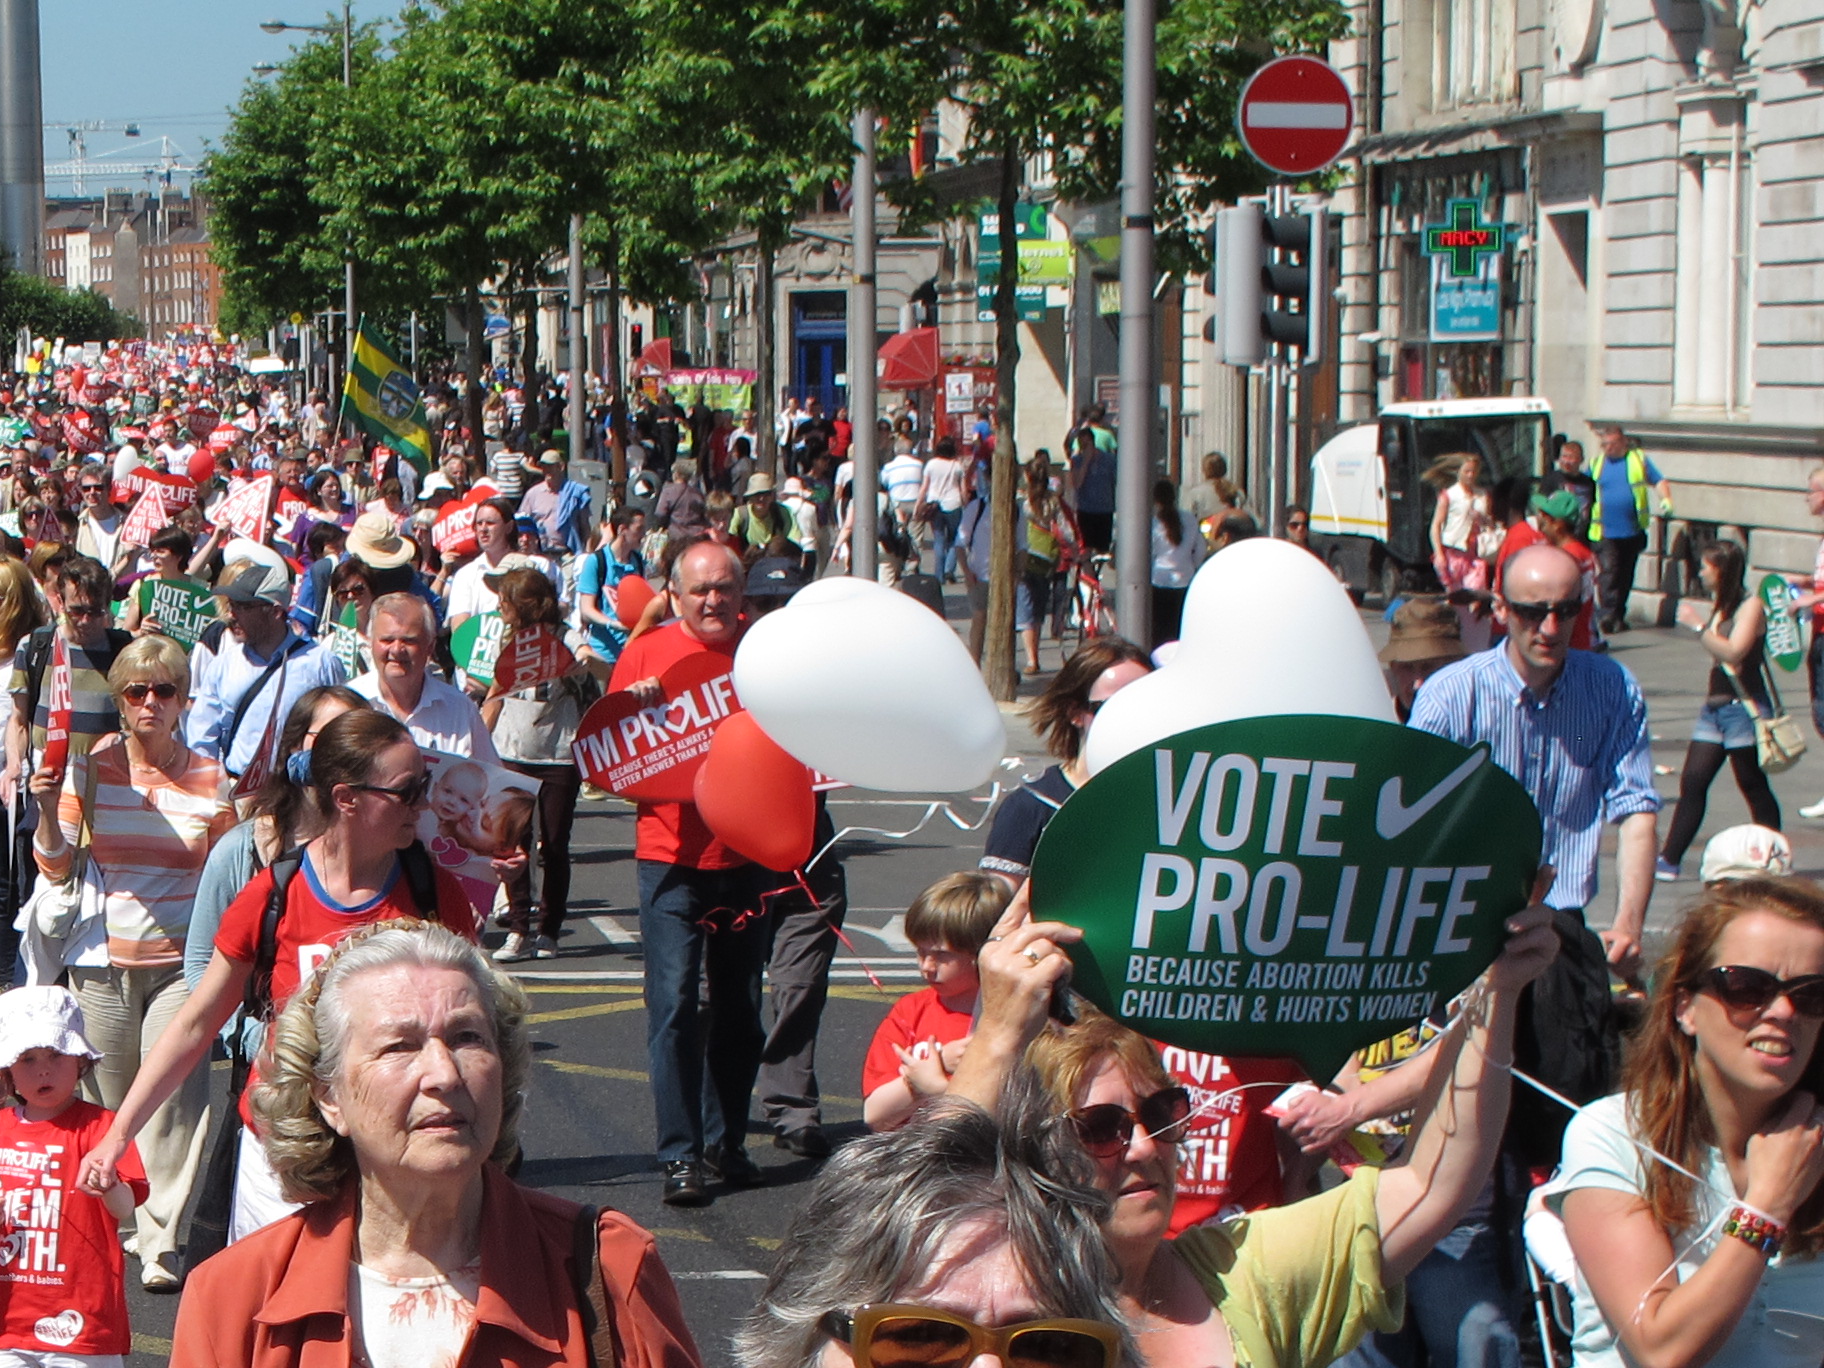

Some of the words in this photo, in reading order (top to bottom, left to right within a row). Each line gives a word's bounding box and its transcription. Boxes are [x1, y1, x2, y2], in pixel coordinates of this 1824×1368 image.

[1439, 231, 1489, 246] MACY
[150, 597, 212, 634] PRO-LIF
[153, 580, 192, 610] VOTE
[572, 726, 622, 780] I'M
[618, 671, 745, 758] PROLIF
[607, 757, 645, 782] BECAUSE
[642, 743, 677, 763] THERE'S
[675, 729, 708, 751] ALWAYS
[611, 772, 643, 793] BETTER
[642, 757, 677, 780] ANSWER
[675, 744, 699, 764] THAN
[1154, 748, 1357, 858] VOTE
[1130, 851, 1492, 958] PRO-LIFE
[1126, 955, 1242, 990] BECAUSE
[1245, 961, 1364, 991] ABORTION
[1368, 960, 1432, 989] KILLS
[1119, 988, 1243, 1024] CHILDREN
[1250, 996, 1269, 1023] &
[1275, 996, 1351, 1024] HURTS
[1357, 992, 1438, 1021] WOMEN
